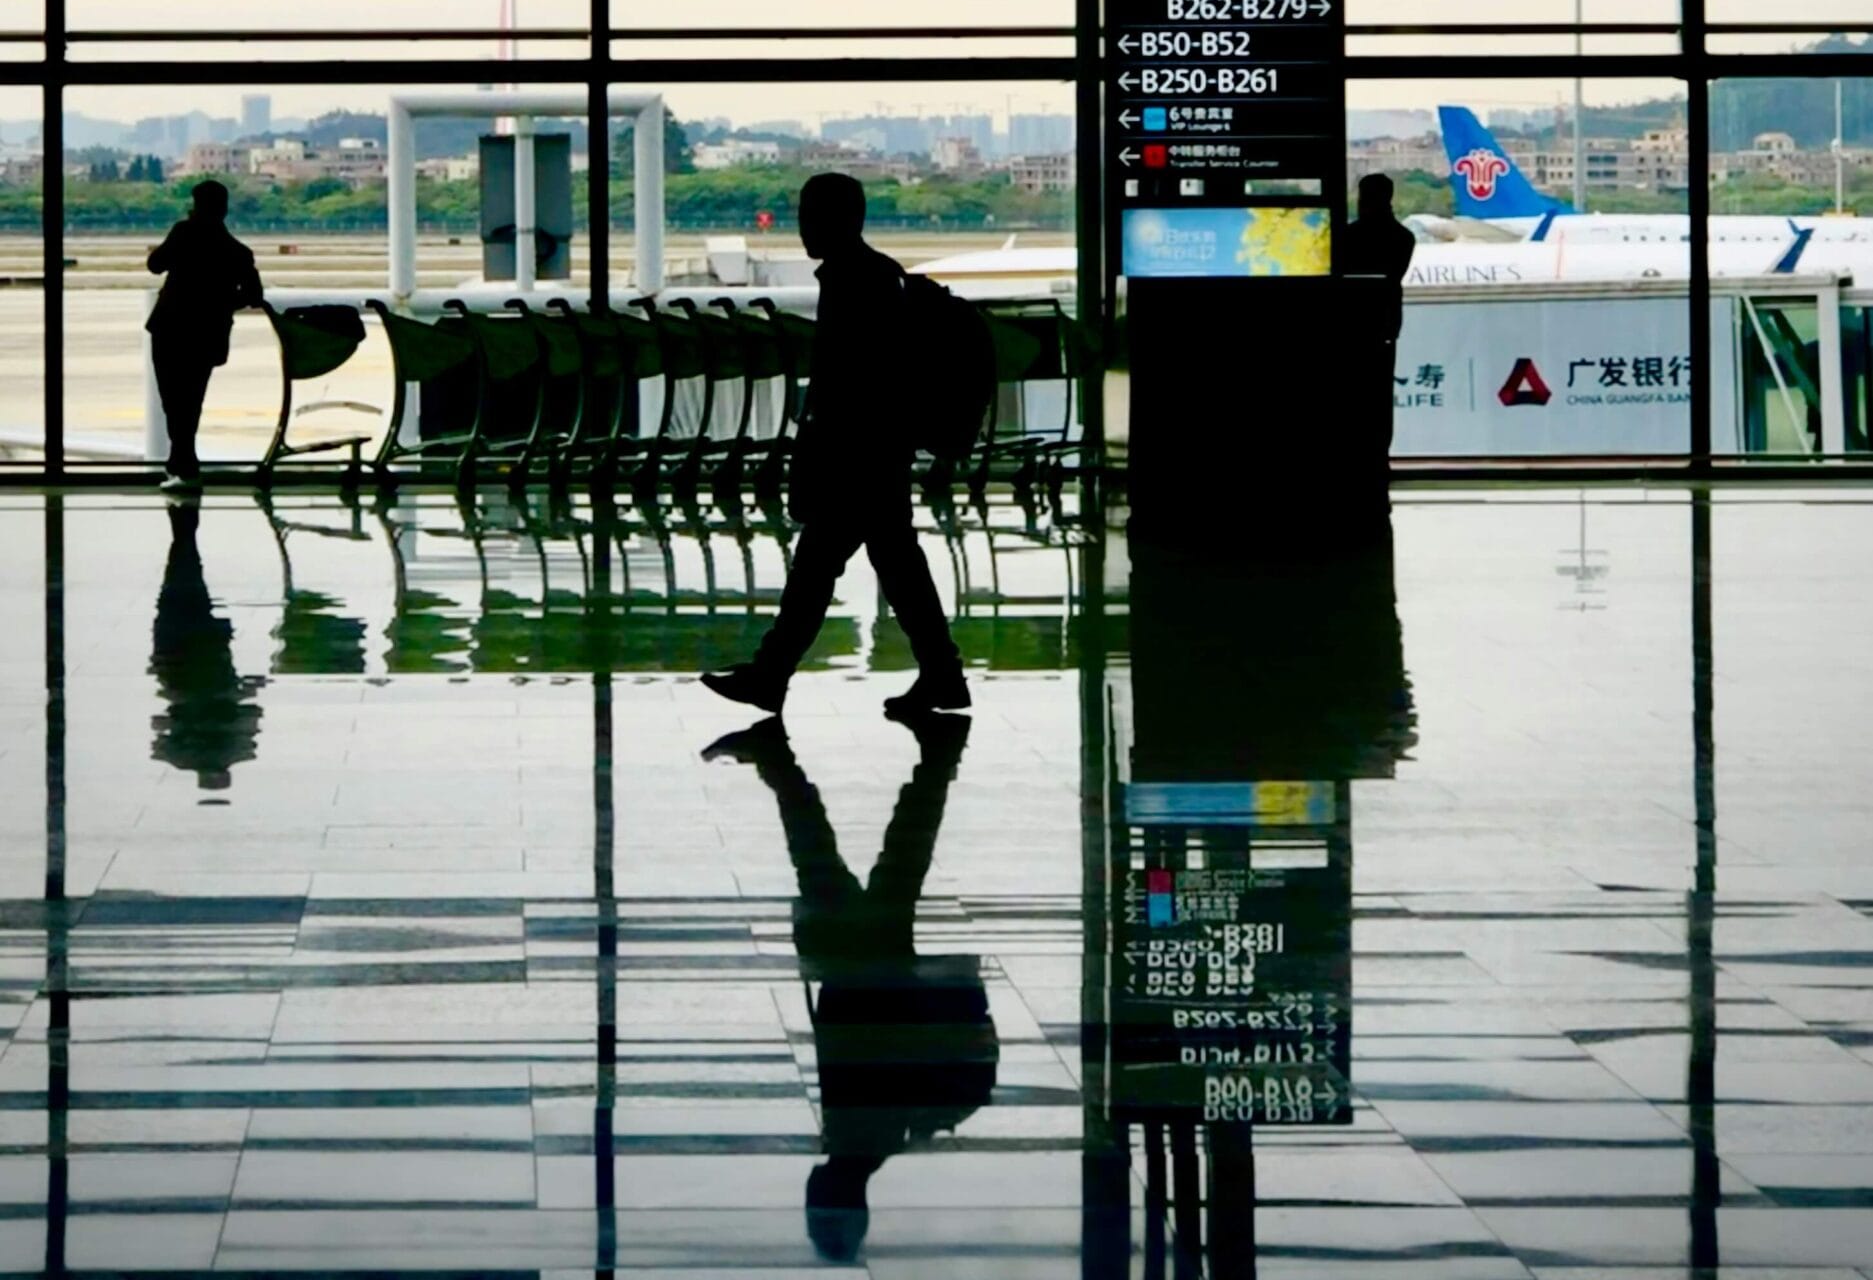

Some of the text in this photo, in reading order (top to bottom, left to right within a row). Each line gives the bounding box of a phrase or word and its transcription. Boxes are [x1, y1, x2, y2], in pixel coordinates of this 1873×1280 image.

[1141, 32, 1250, 56] B50-B52
[1141, 69, 1277, 93] B250-B261
[1409, 264, 1522, 283] AIRLINES
[1567, 356, 1691, 387] 广发银行
[1567, 395, 1602, 405] CHINA
